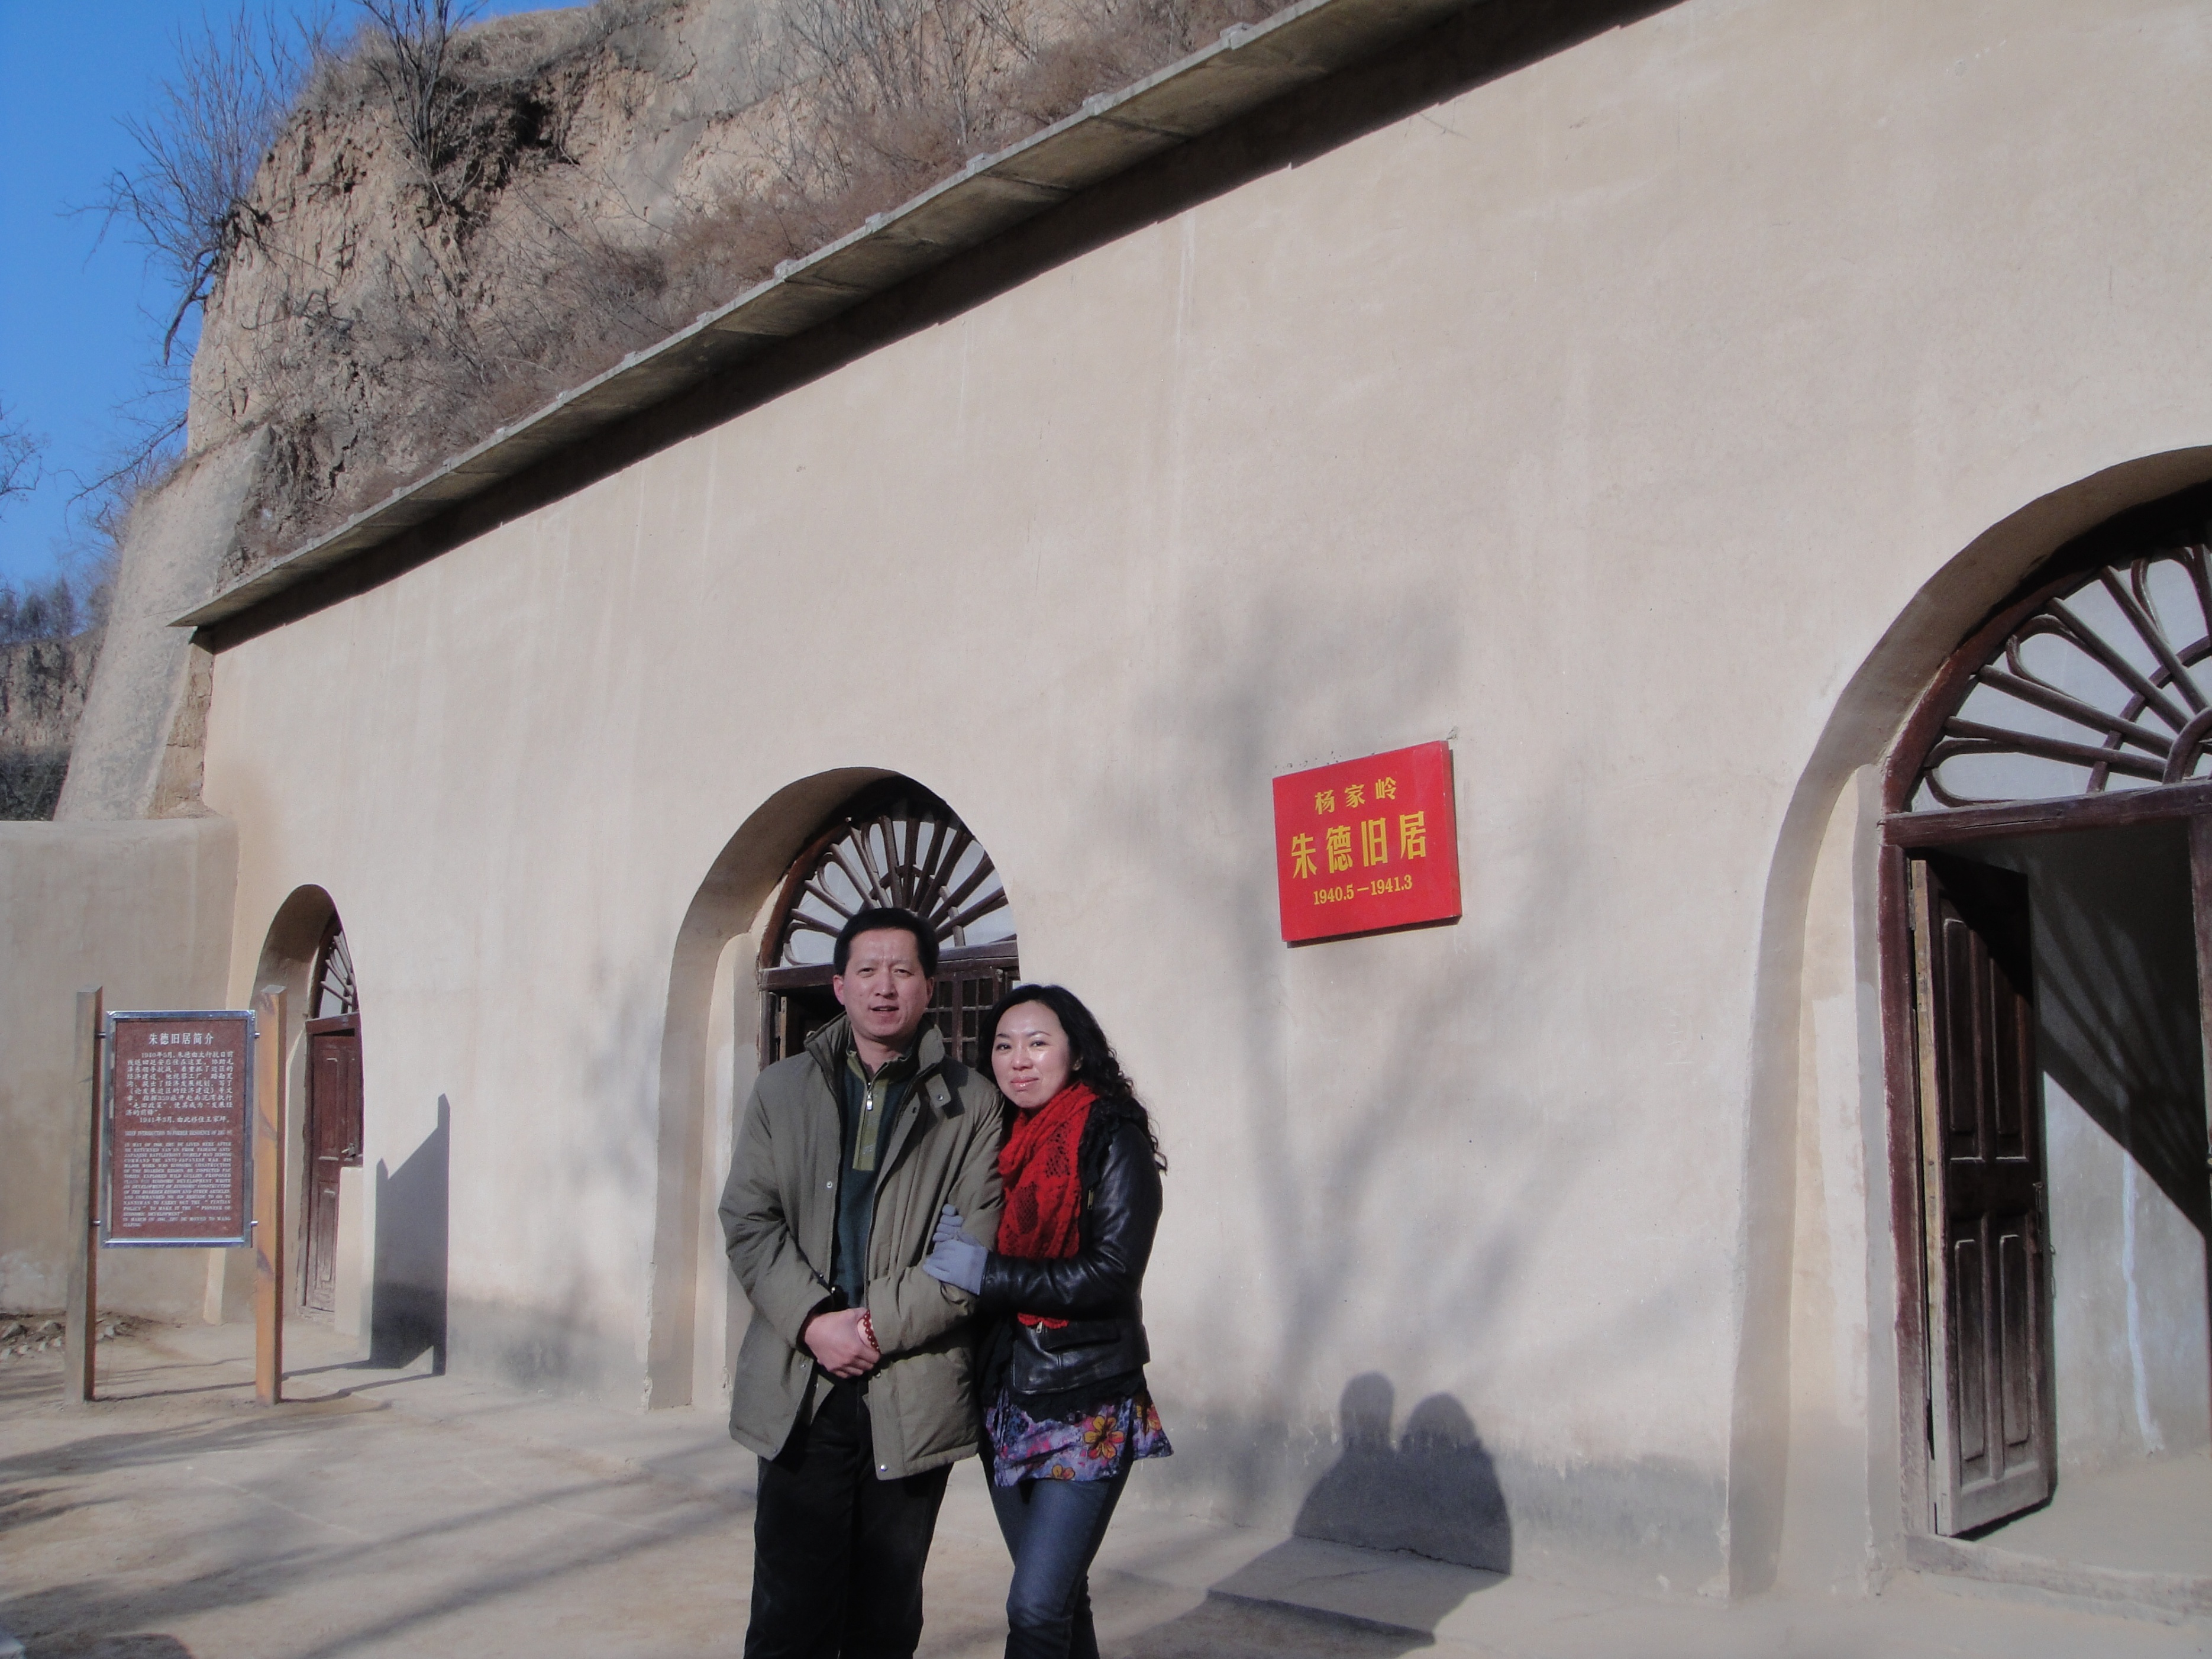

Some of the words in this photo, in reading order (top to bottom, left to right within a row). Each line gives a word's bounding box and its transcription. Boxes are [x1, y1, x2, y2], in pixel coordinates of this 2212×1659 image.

[1315, 777, 1397, 815] 杨家岭
[1291, 811, 1426, 879] 朱德旧居
[148, 1032, 214, 1045] 朱德旧居简介
